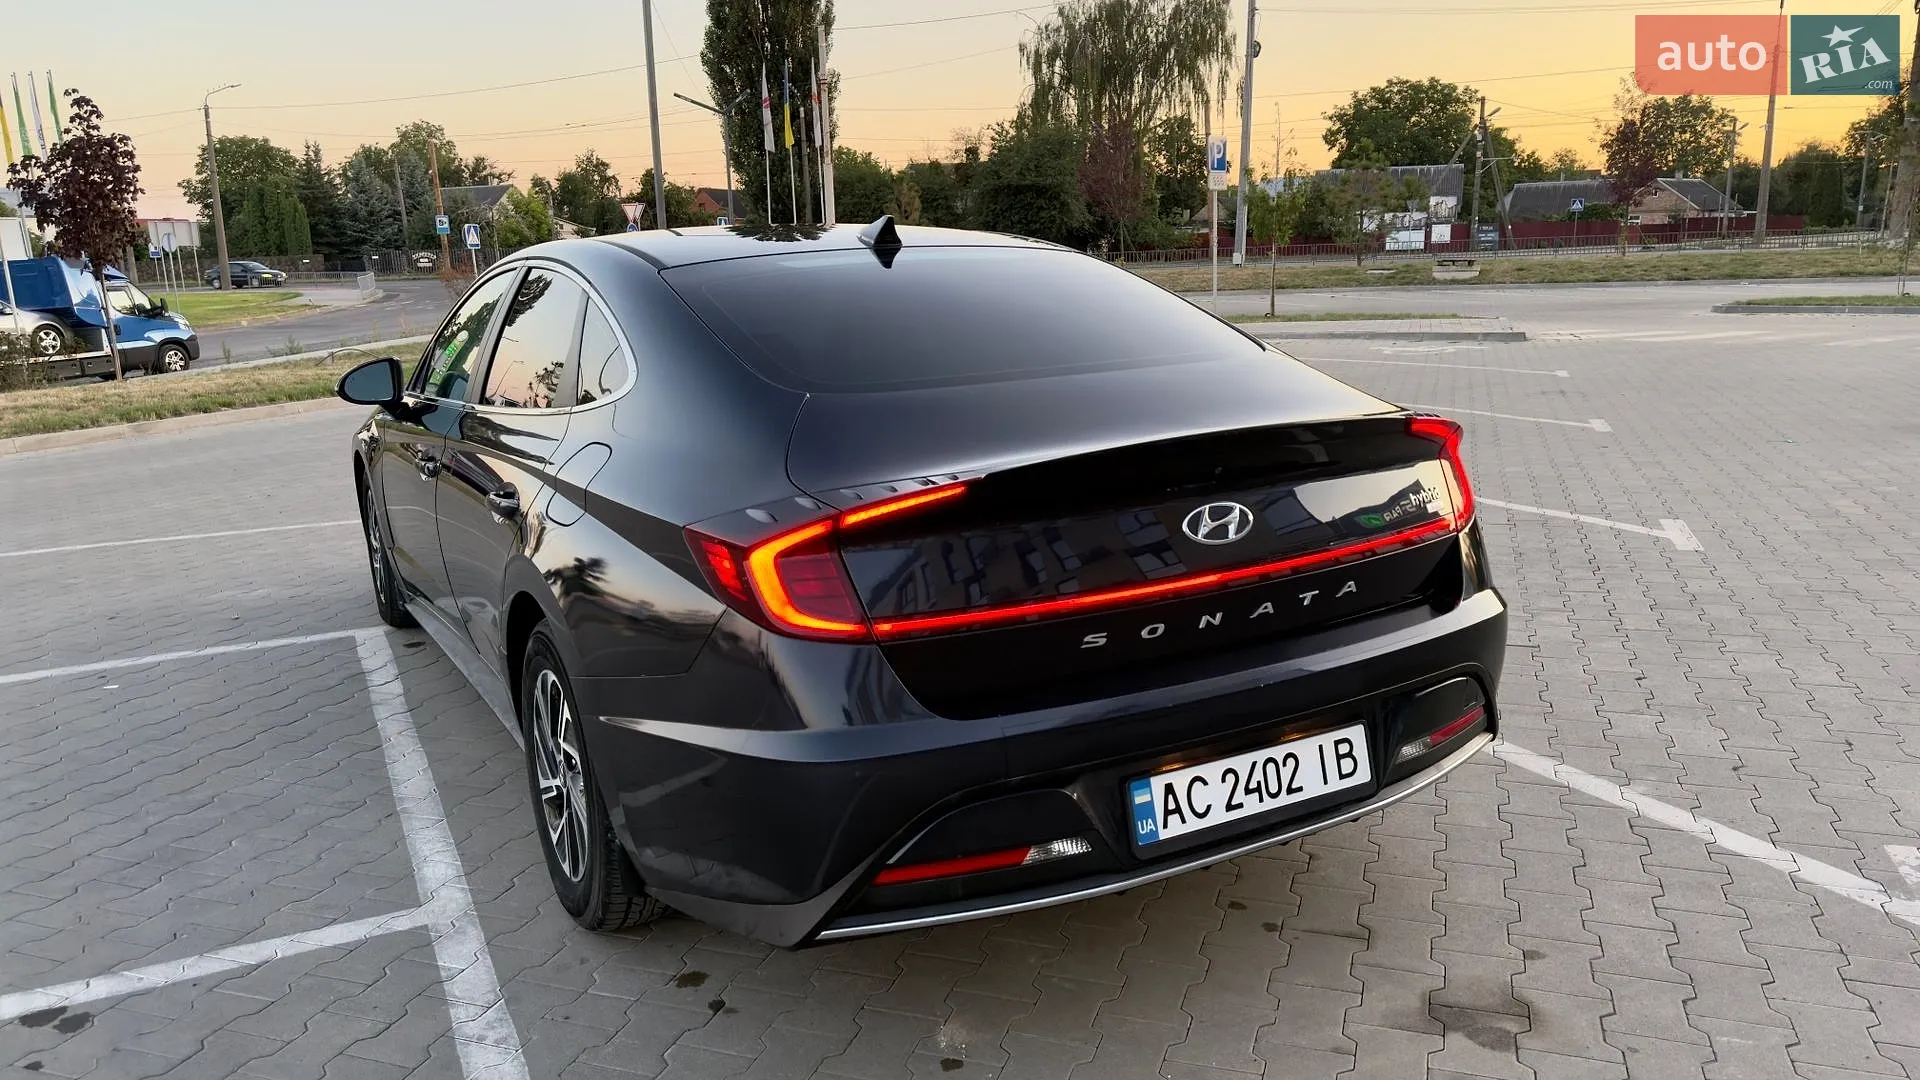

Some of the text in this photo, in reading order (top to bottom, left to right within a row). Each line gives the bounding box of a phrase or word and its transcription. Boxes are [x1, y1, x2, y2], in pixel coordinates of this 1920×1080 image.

[1214, 143, 1224, 168] P
[1409, 487, 1440, 507] hybrid
[1080, 581, 1357, 649] SONATA
[1162, 736, 1358, 830] AC 2402 IB
[1138, 818, 1156, 835] UA
